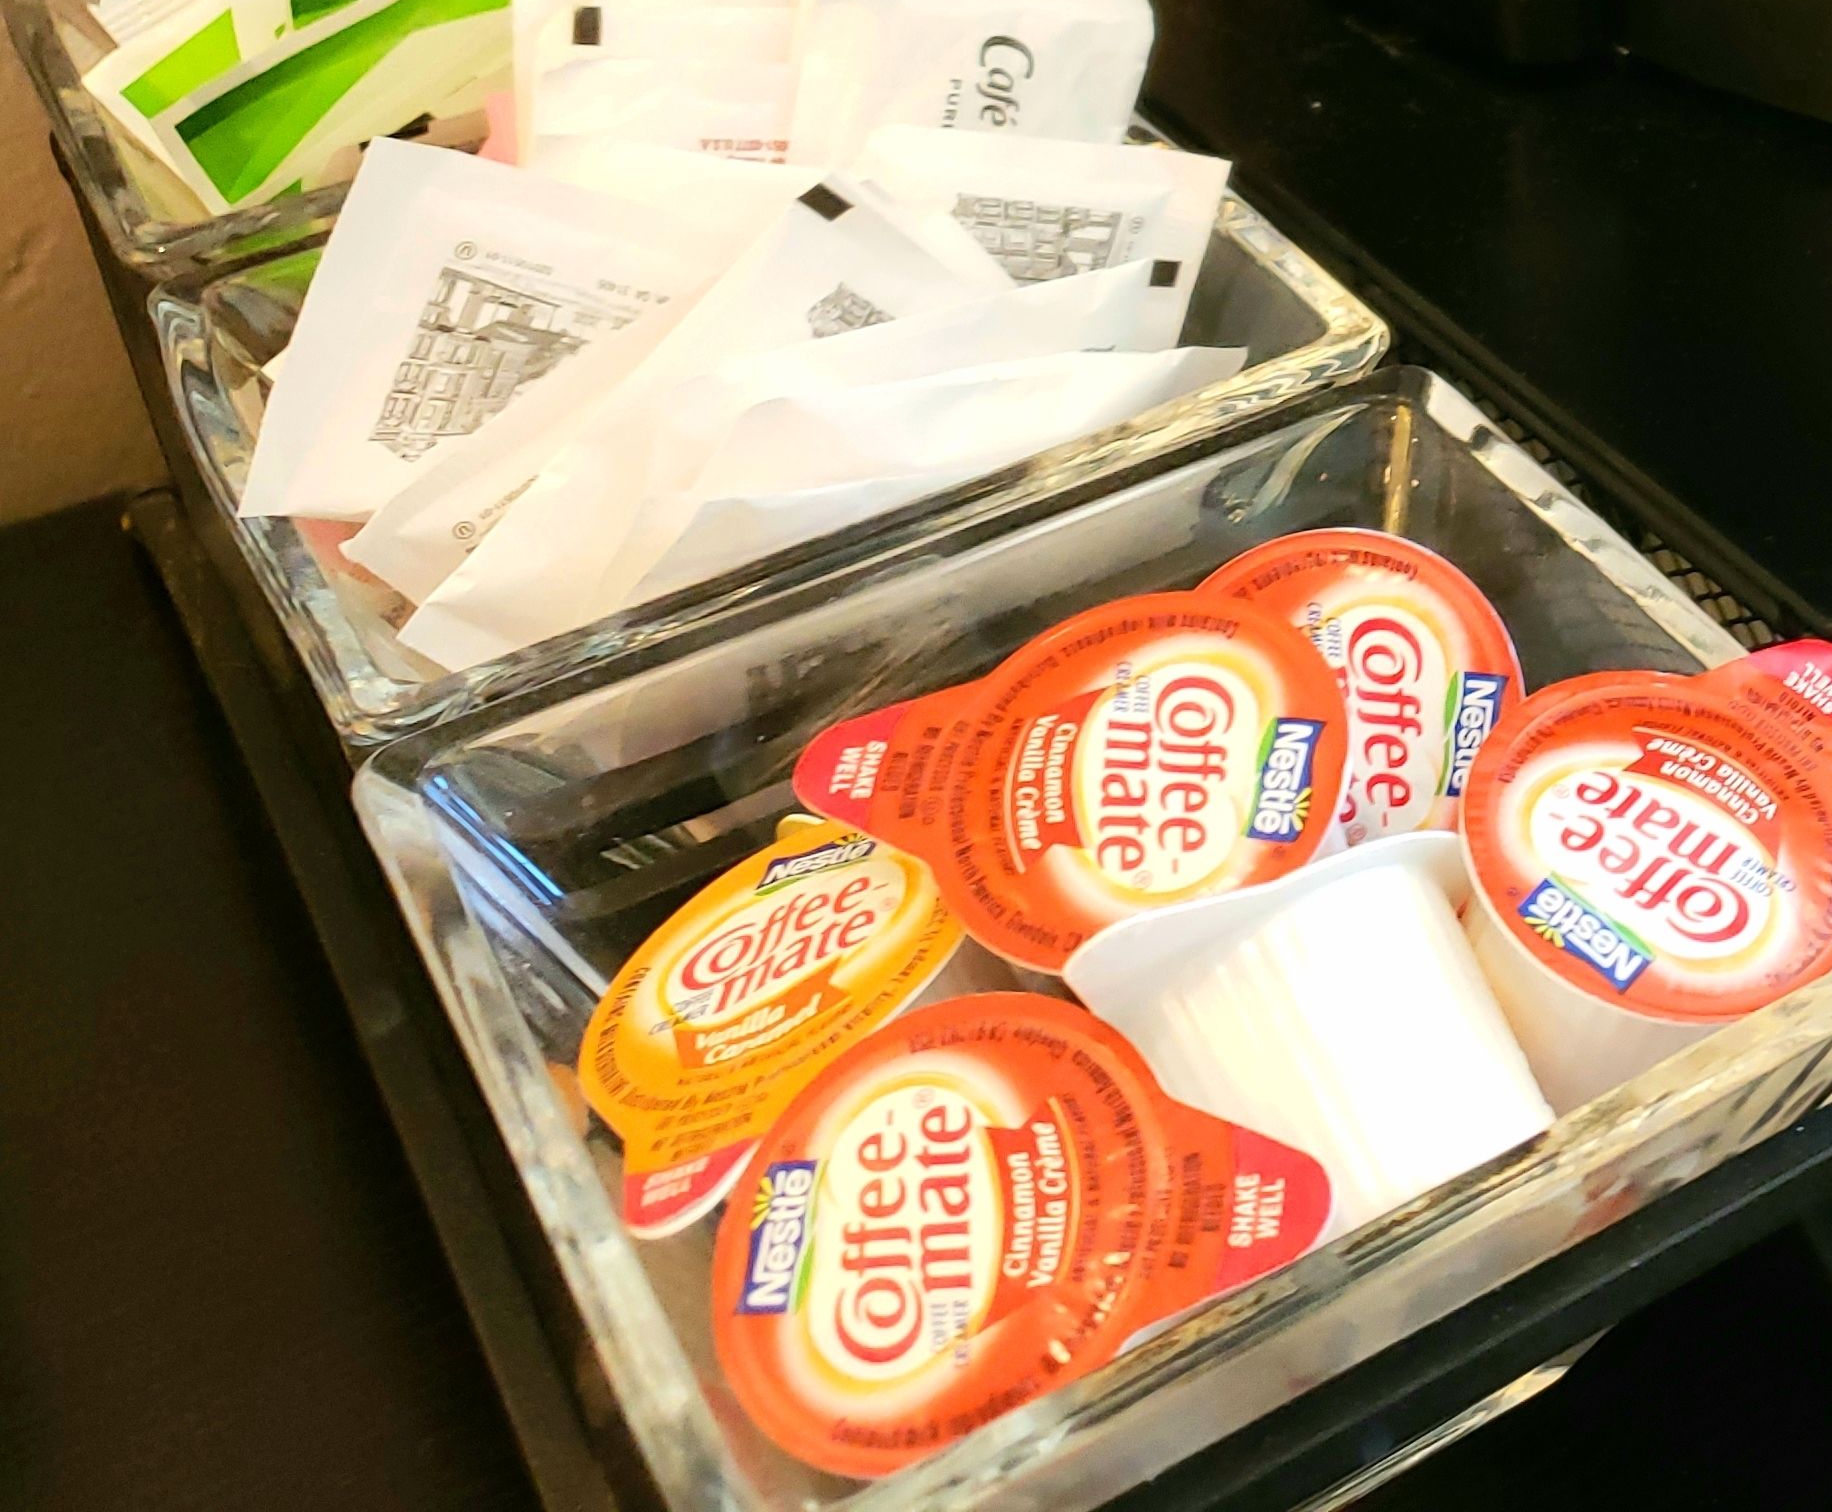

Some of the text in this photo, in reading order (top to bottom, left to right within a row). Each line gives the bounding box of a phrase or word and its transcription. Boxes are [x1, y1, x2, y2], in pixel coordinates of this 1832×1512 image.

[975, 35, 1035, 127] Café
[1113, 660, 1132, 713] CREAMER
[1133, 674, 1151, 713] COFFEE
[828, 746, 865, 794] WELL
[849, 739, 889, 800] SHAKE
[1017, 714, 1060, 783] Vanilla
[1043, 721, 1079, 824] Cinnamon
[1254, 723, 1315, 836] Nestlé
[1646, 737, 1779, 822] Vanilla Crème
[1659, 760, 1761, 826] Cinnamon
[1014, 785, 1043, 851] Crème
[1096, 719, 1153, 872] mate
[1576, 770, 1742, 876] mate
[713, 910, 876, 1015] mate
[1527, 886, 1644, 982] Nestlé
[746, 1167, 814, 1307] Nestlé
[914, 1104, 974, 1293] mate
[1002, 1150, 1036, 1278] Cinnamon
[1025, 1121, 1068, 1289] Vanilla Crème
[1226, 1172, 1261, 1248] SHAKE
[1254, 1177, 1287, 1240] WELL
